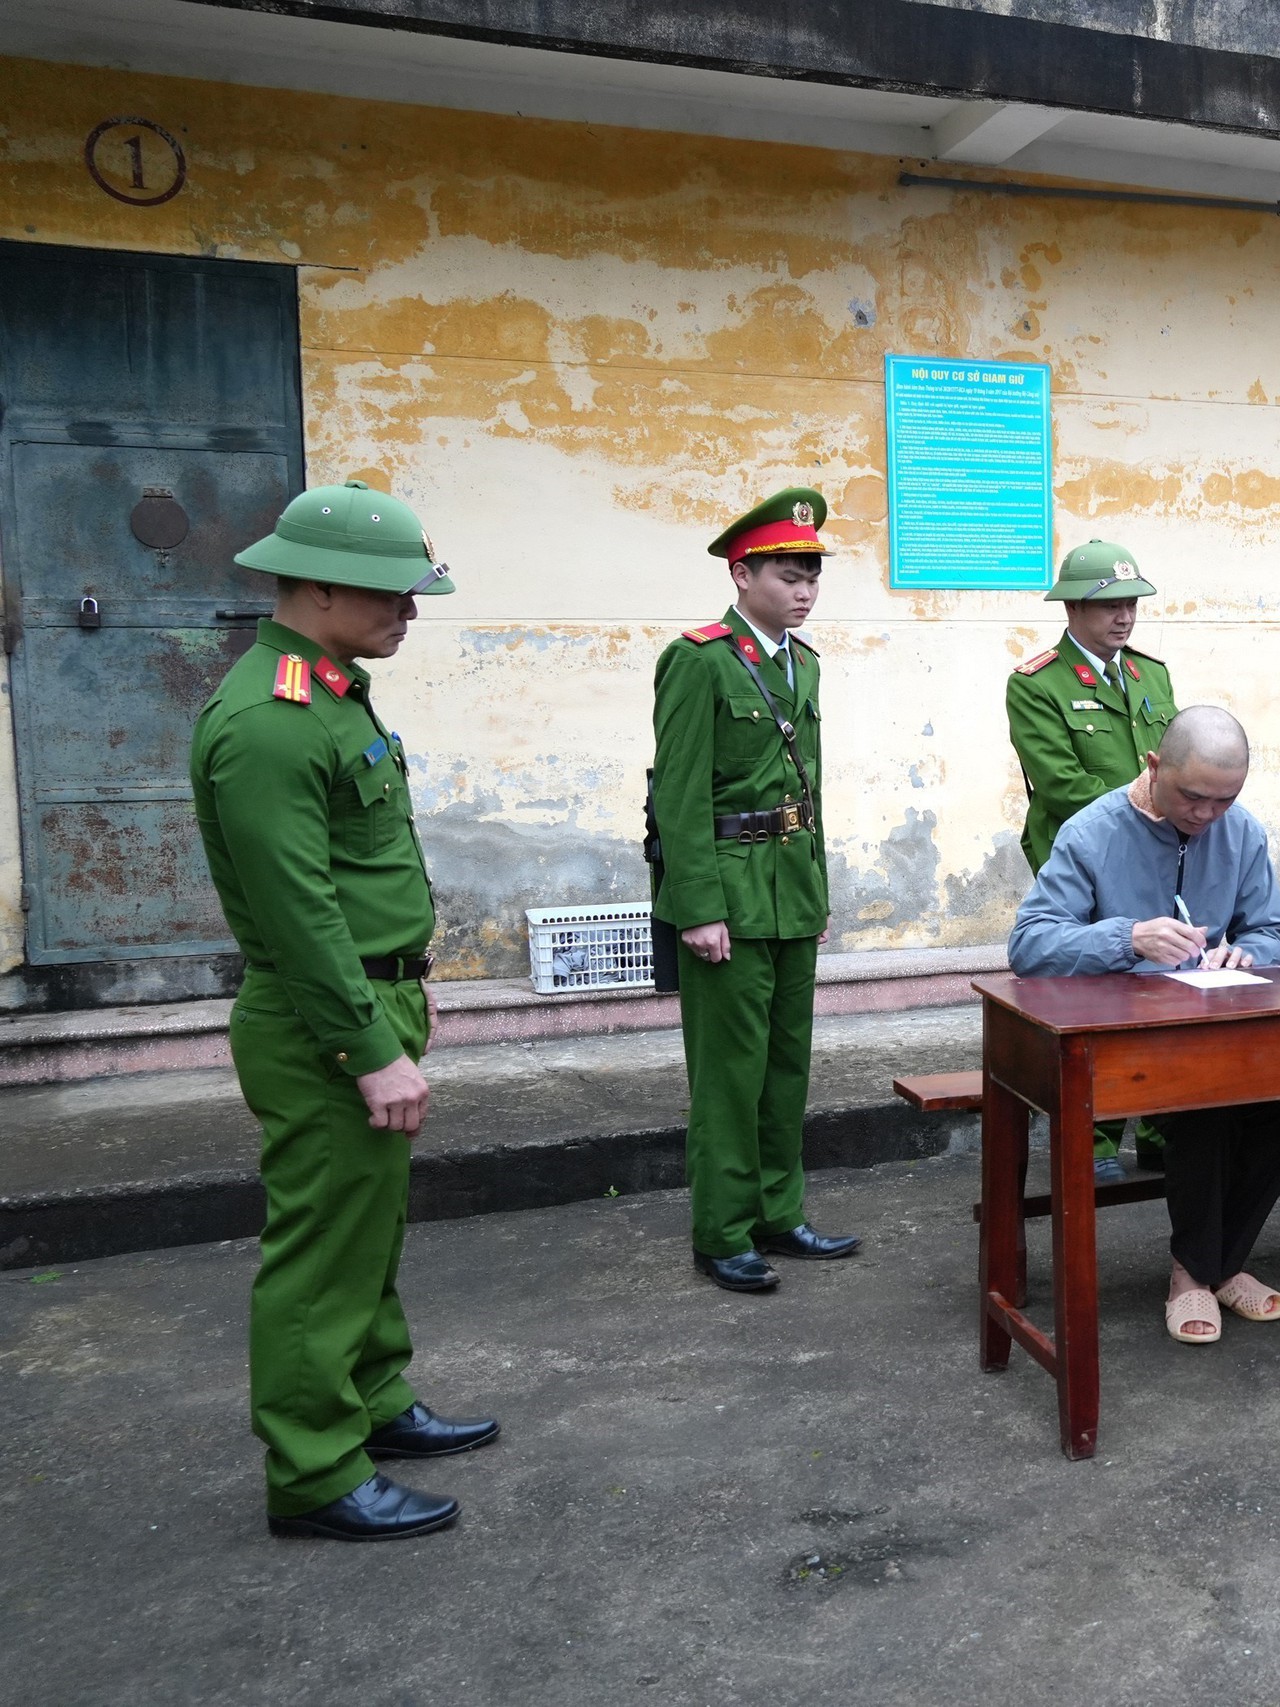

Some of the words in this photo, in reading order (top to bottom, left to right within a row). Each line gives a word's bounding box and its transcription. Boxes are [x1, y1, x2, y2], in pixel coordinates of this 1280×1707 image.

[123, 135, 148, 190] 1
[912, 368, 928, 380] NỘI
[931, 370, 949, 381] QUY
[952, 371, 965, 381] CƠ
[967, 369, 980, 382] SỞ
[982, 373, 1006, 384] GIAM
[1009, 374, 1024, 384] GIỮ
